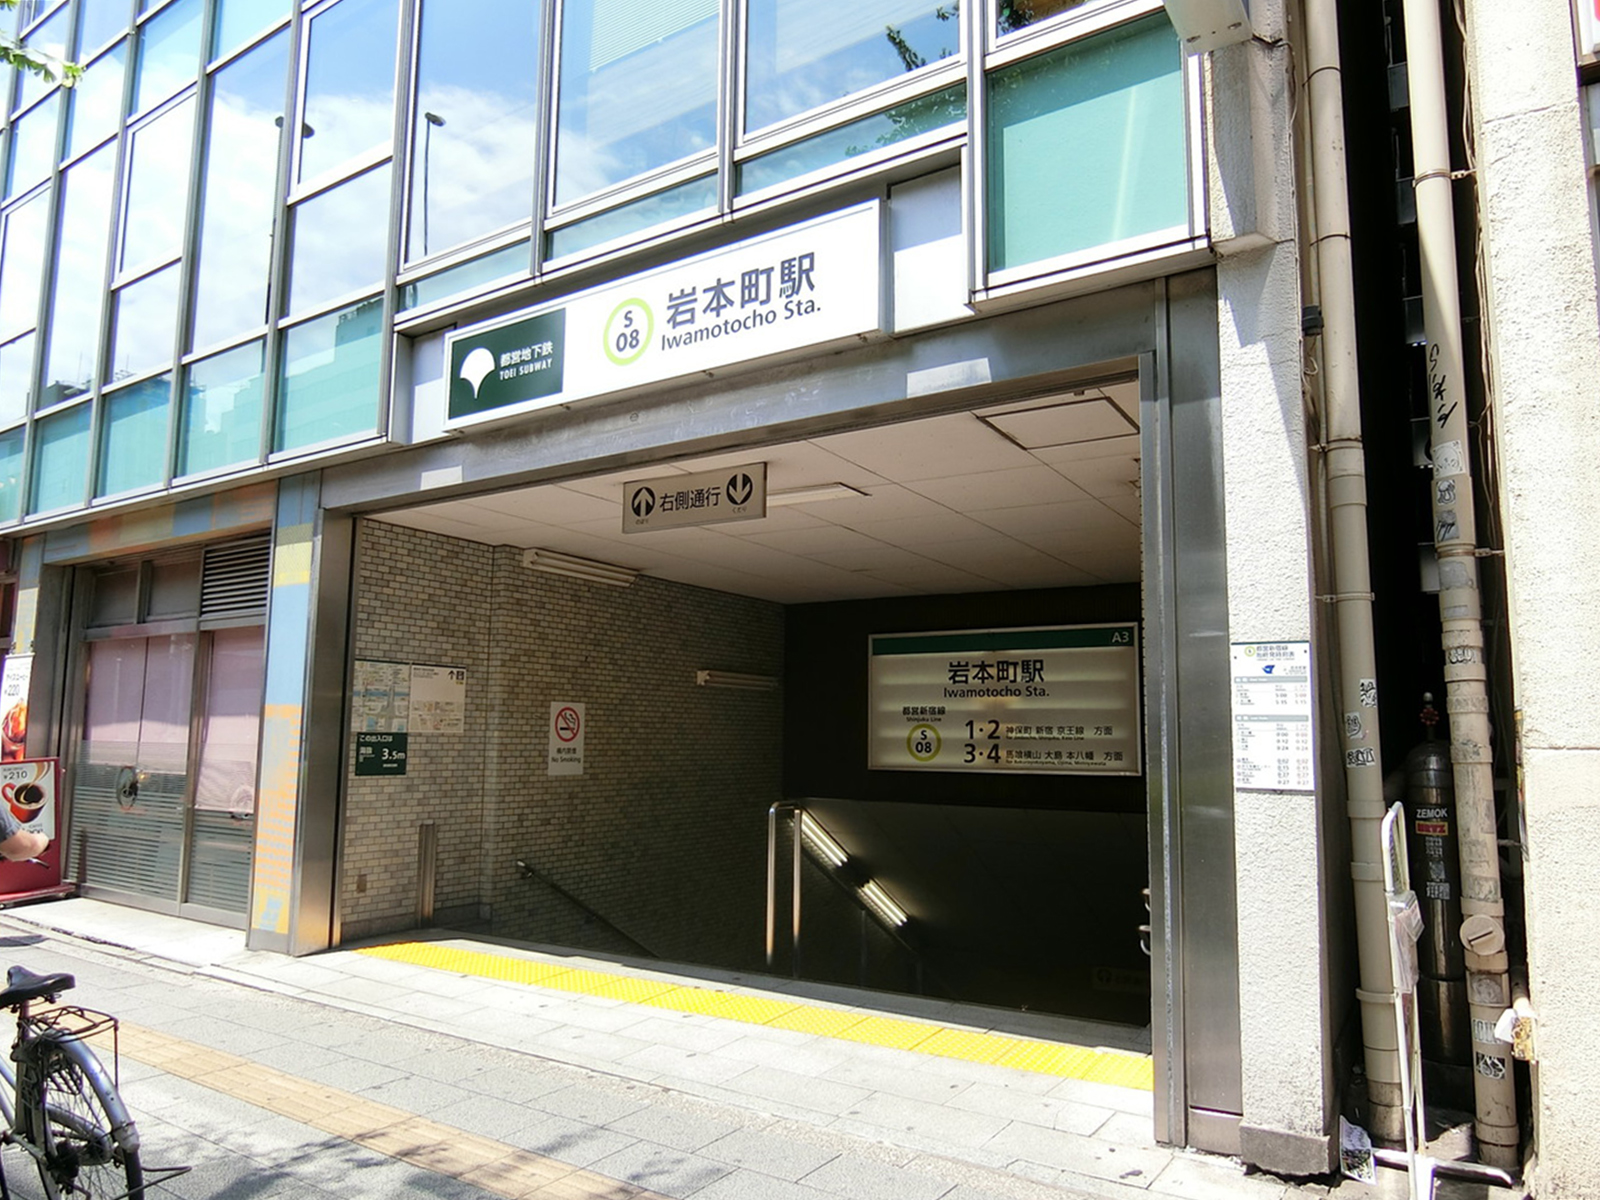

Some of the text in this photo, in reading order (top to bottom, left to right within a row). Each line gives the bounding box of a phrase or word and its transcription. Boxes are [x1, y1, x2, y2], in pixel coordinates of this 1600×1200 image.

[666, 252, 815, 330] 岩本町駅
[624, 310, 634, 328] S
[661, 299, 821, 350] Iwamotocho Sta.
[616, 329, 640, 352] 08
[500, 340, 553, 368] 都営地下鉄
[500, 358, 552, 380] TOEI SUBWAY
[659, 486, 721, 513] 右側通行
[1112, 631, 1130, 643] A3
[948, 659, 1045, 685] 岩本町駅
[943, 685, 1050, 699] Iwamotocho Sta.
[902, 705, 946, 716] 都営新宿線
[920, 729, 928, 741] S
[1035, 725, 1054, 735] 新宿
[1056, 725, 1085, 735] 京王線
[1093, 725, 1113, 736] 方面
[381, 747, 406, 760] 3.5m
[915, 741, 932, 754] 08
[1103, 751, 1123, 761] 方面
[1416, 807, 1448, 818] ZEMOK
